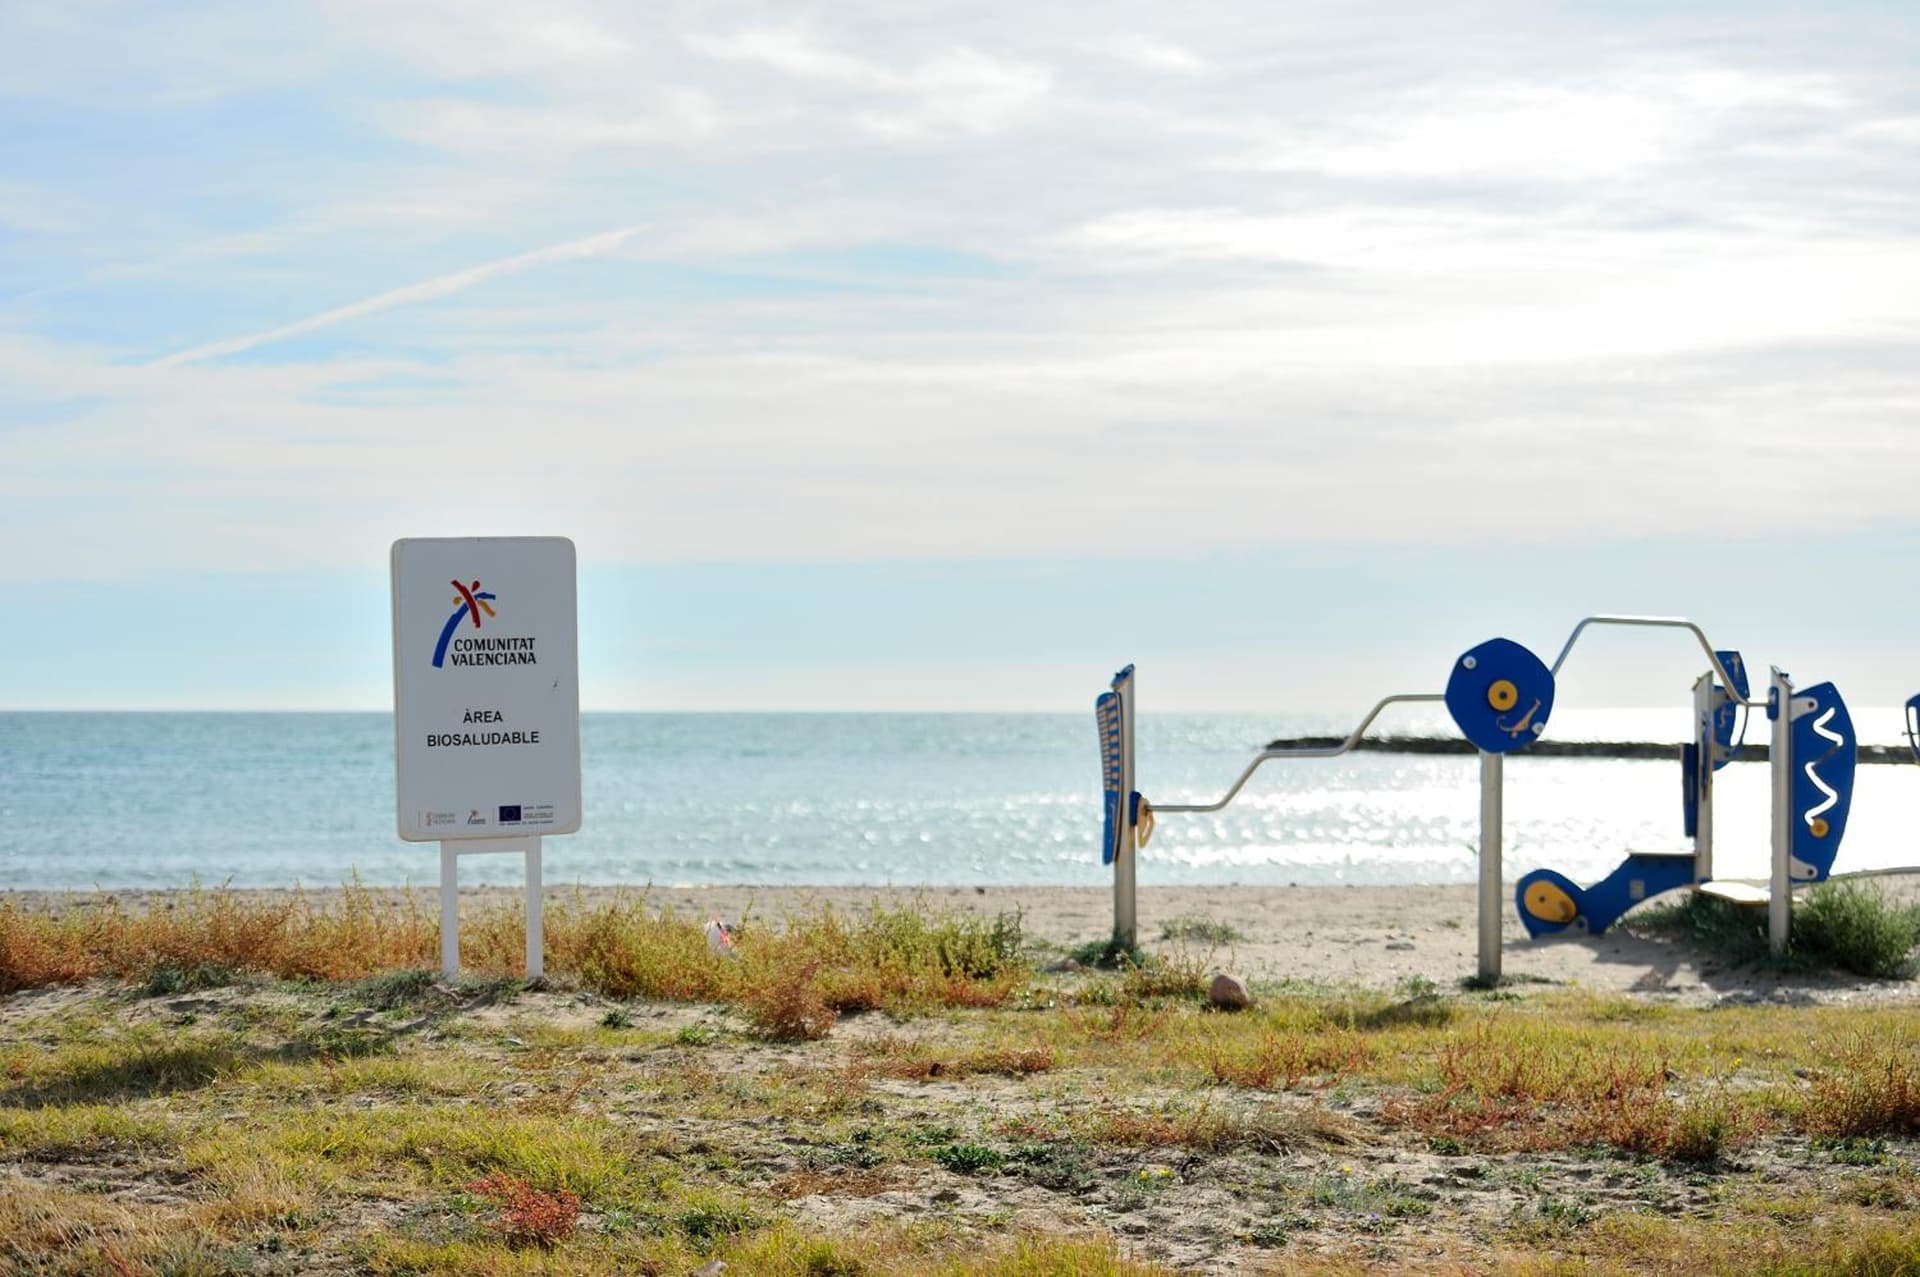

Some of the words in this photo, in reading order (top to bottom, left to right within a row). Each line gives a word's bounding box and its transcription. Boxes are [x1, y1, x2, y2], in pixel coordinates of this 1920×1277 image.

[454, 638, 536, 652] COMUNITAT
[451, 652, 537, 666] VALENCIANA
[427, 731, 540, 747] BIOSALUDABLE
